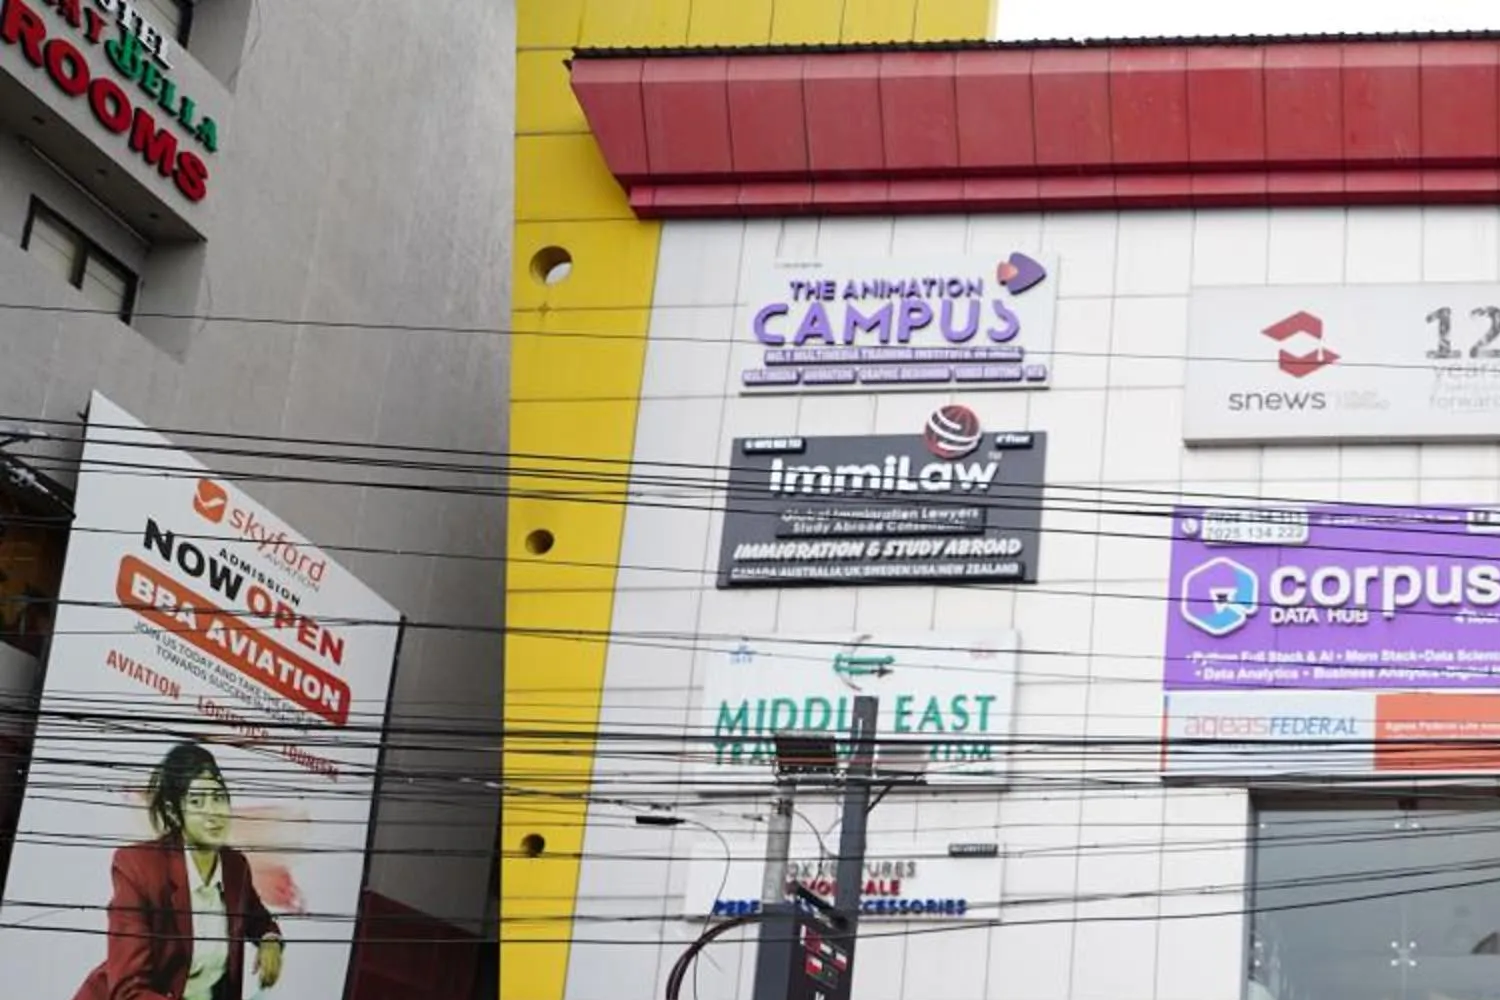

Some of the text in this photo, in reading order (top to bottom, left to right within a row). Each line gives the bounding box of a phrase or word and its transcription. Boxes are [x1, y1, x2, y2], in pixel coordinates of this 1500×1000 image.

[1, 0, 209, 202] ROOMS
[789, 277, 985, 301] THE ANIMATION
[753, 299, 1020, 346] CAMPUS
[1228, 391, 1326, 411] snews
[769, 455, 998, 493] ImmiLaw
[229, 508, 326, 583] skyford
[882, 538, 945, 557] STUDY
[946, 537, 1023, 555] ABROAD
[143, 518, 345, 666] NOW OPEN
[219, 548, 301, 606] ADMISSION
[1271, 607, 1369, 624] DATA HUB
[107, 649, 181, 700] AVIATION
[206, 619, 341, 713] AVIATION
[715, 695, 996, 737] MIDDL EAST
